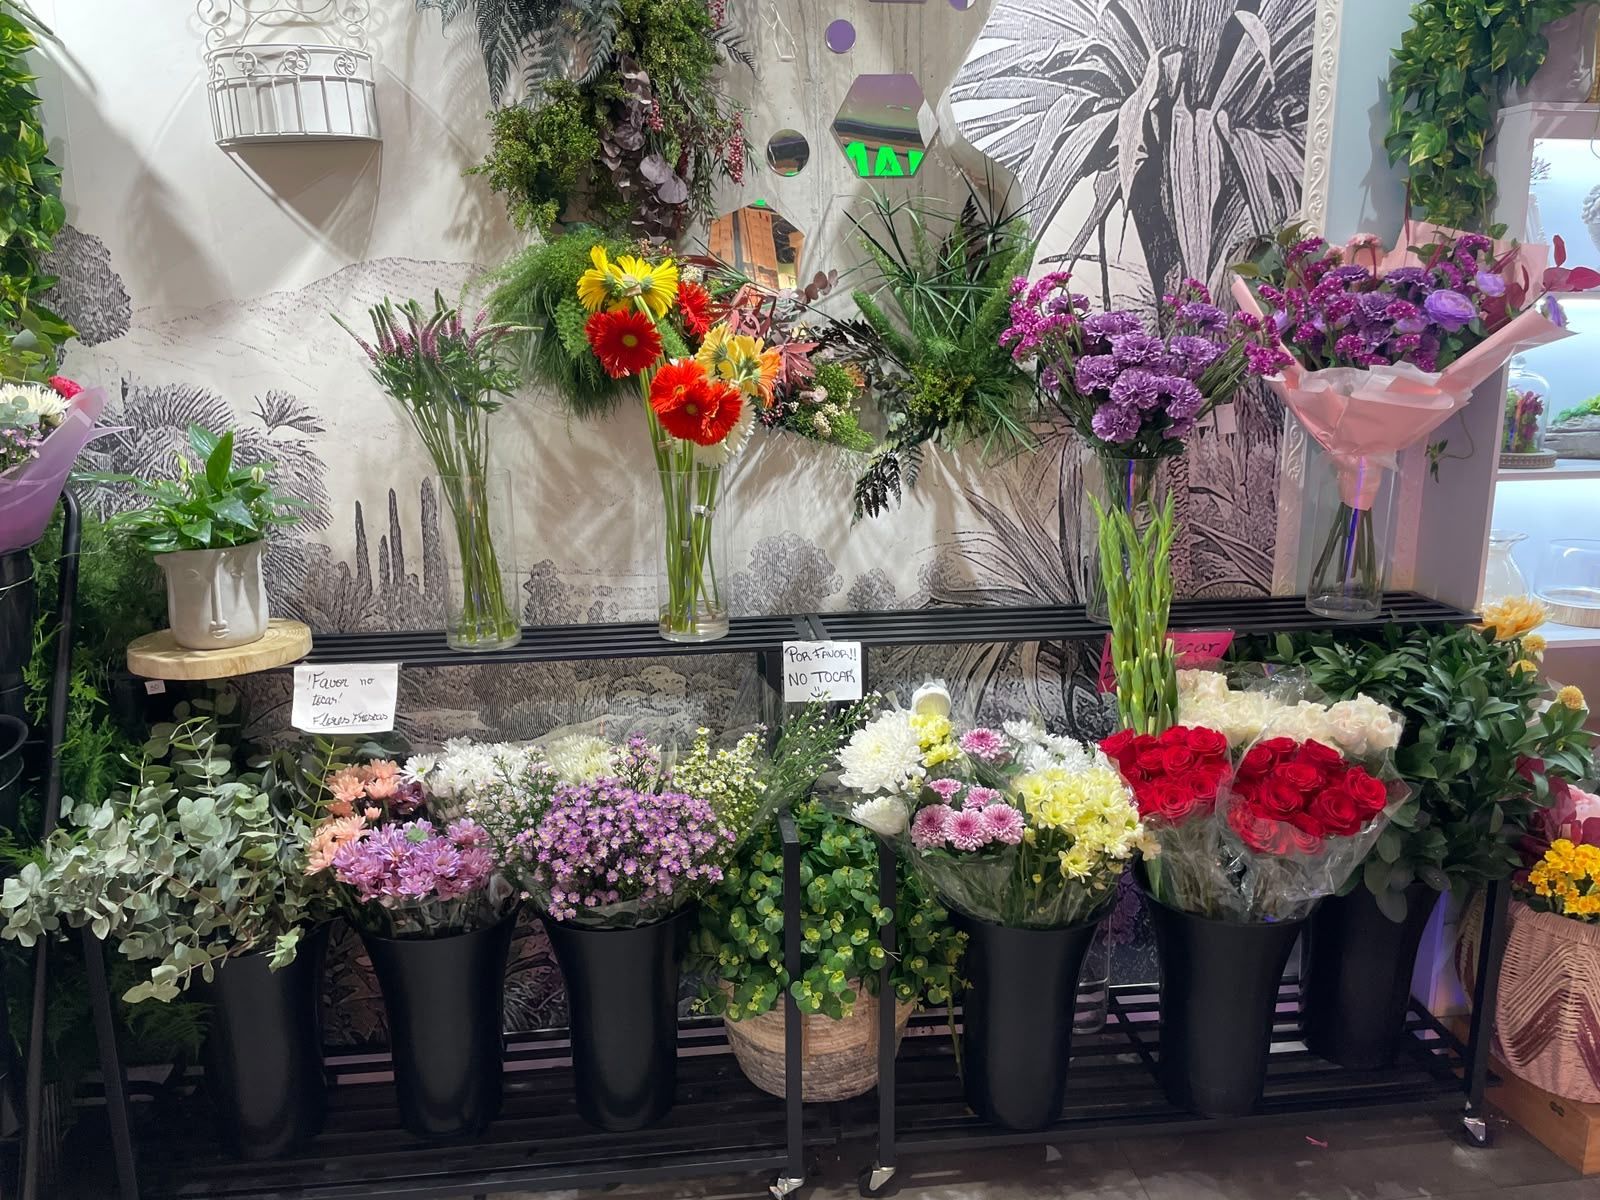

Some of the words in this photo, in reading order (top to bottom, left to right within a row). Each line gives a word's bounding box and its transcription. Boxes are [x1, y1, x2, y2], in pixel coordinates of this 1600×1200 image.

[360, 678, 375, 686] no
[788, 672, 808, 687] NO
[811, 669, 856, 683] TOCAR
